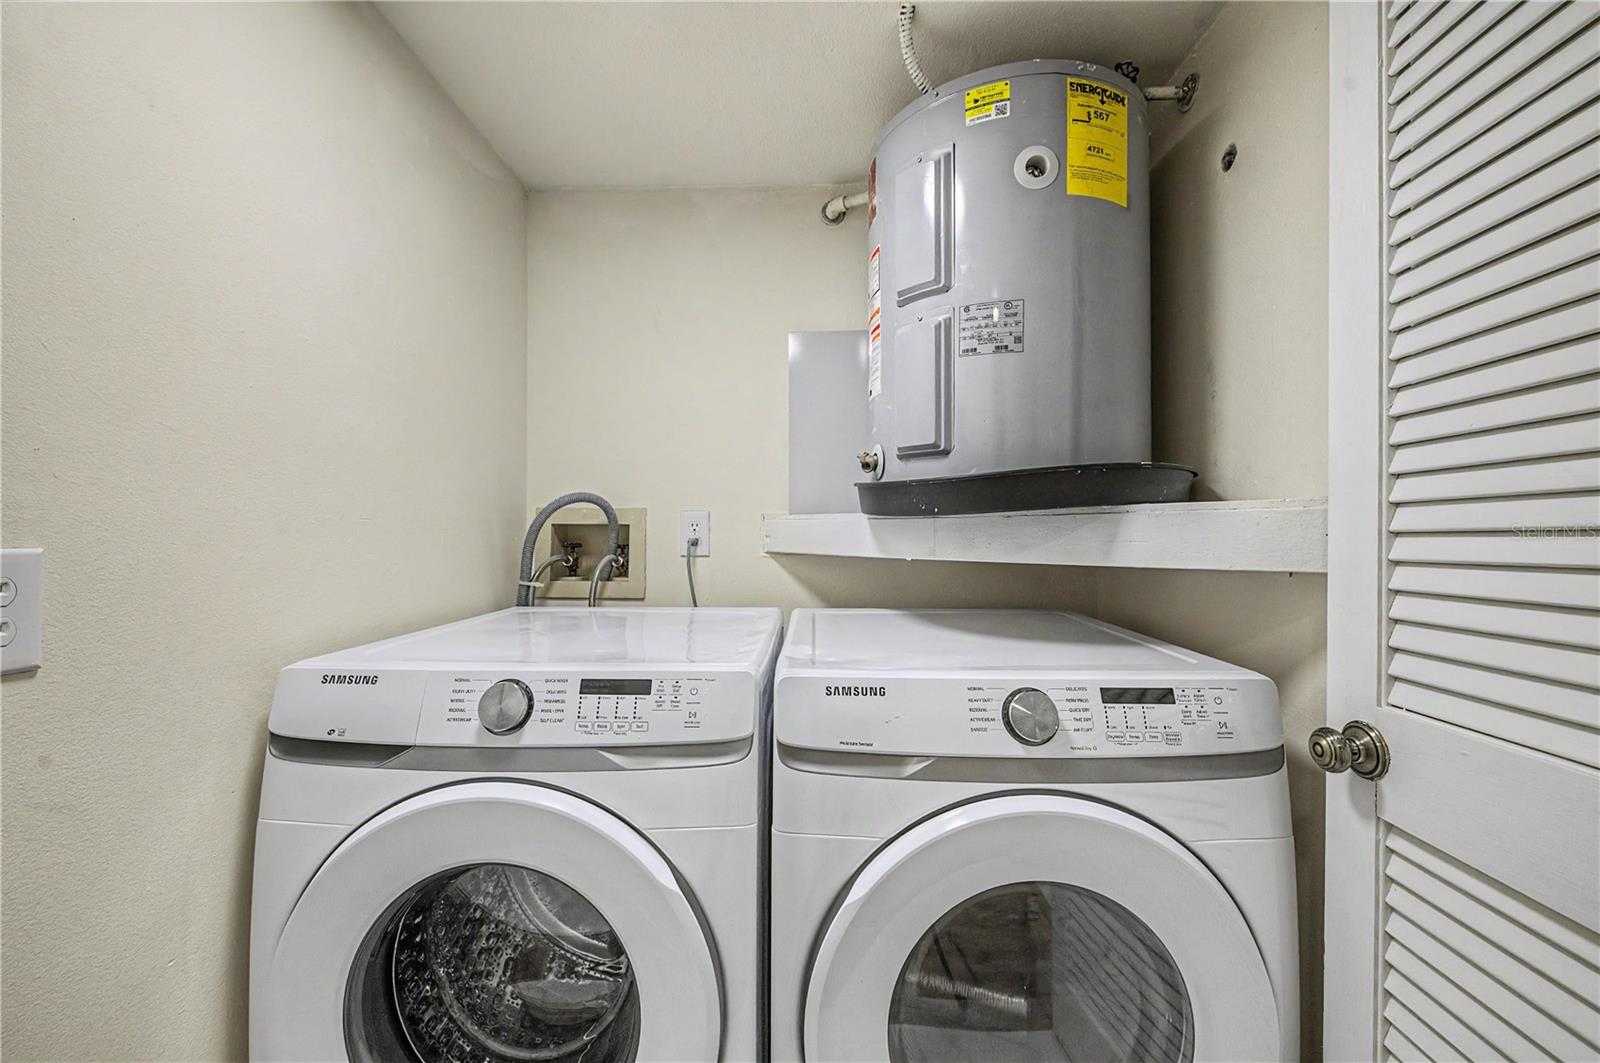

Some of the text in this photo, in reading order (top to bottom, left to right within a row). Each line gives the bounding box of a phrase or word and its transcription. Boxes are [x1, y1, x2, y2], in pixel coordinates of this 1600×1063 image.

[1087, 145, 1104, 155] 4721
[321, 674, 379, 685] SAMSUNG
[825, 685, 886, 697] SAMSUNG
